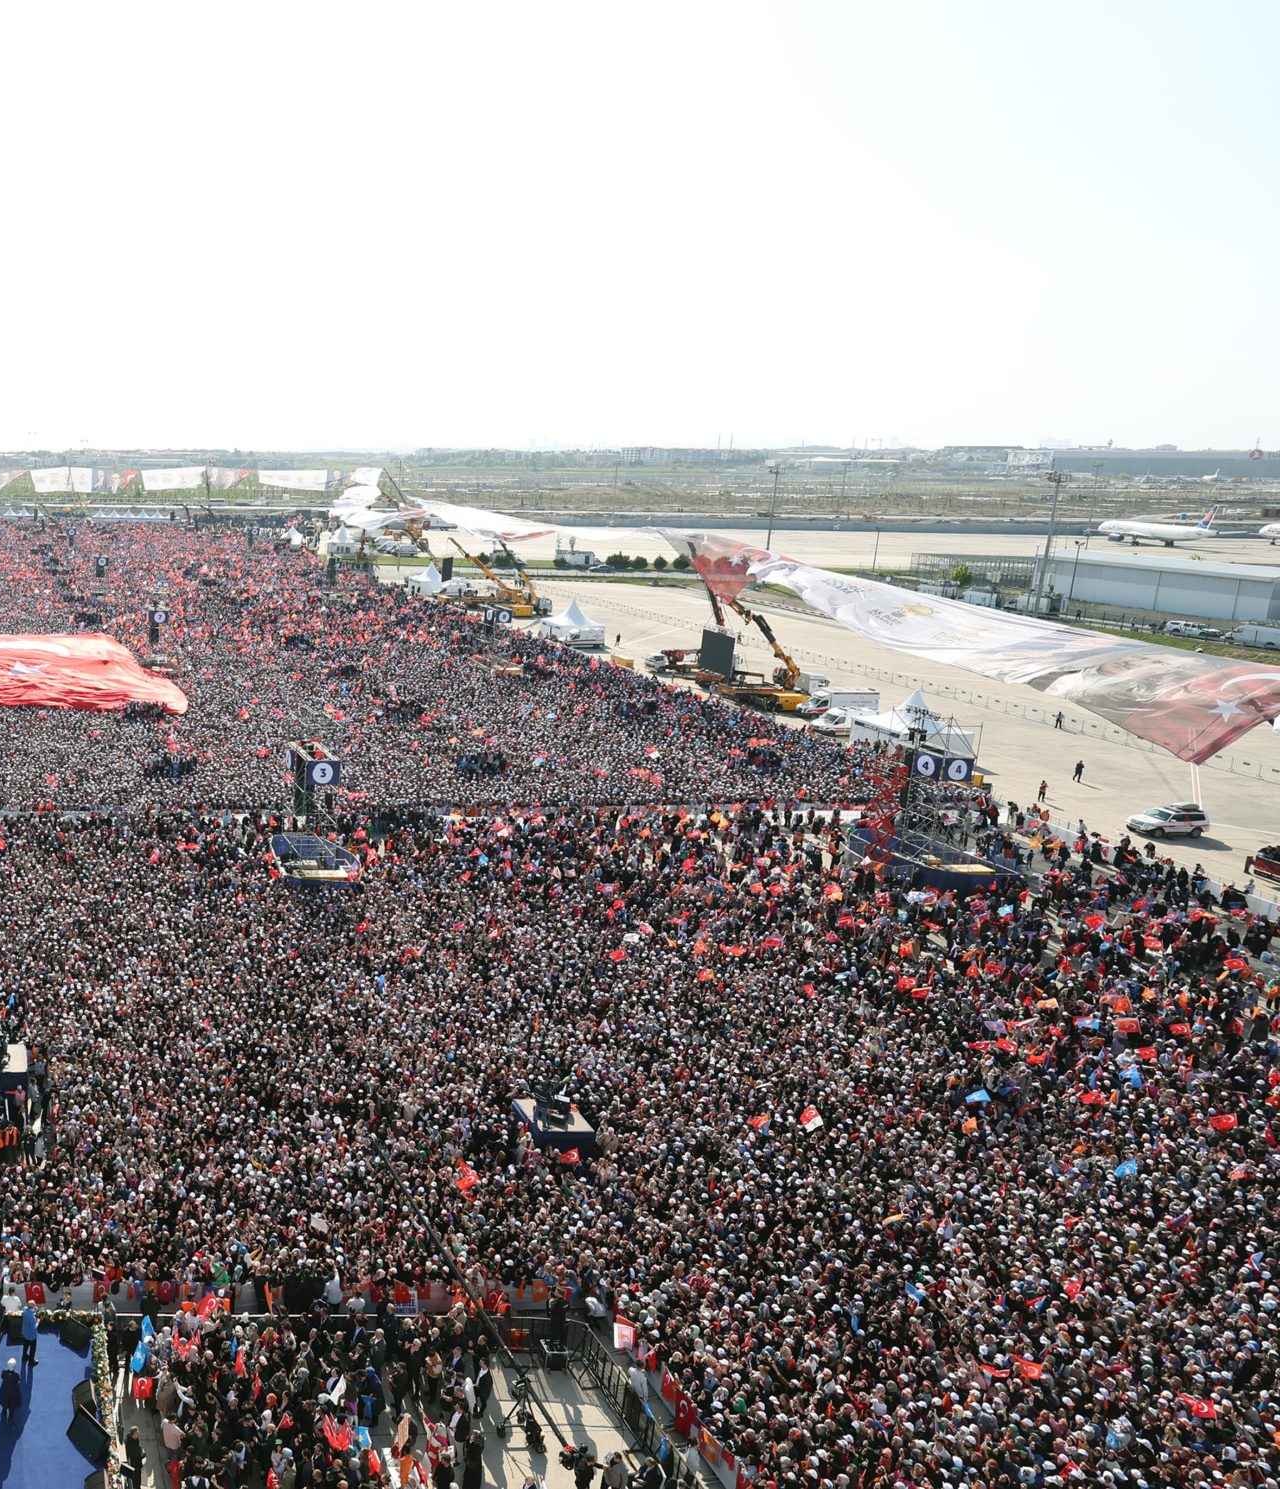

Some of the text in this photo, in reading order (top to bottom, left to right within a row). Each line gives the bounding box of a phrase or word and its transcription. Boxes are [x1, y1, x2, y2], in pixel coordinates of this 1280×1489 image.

[922, 761, 929, 770] 4
[955, 765, 962, 774] 4
[320, 768, 327, 778] 3
